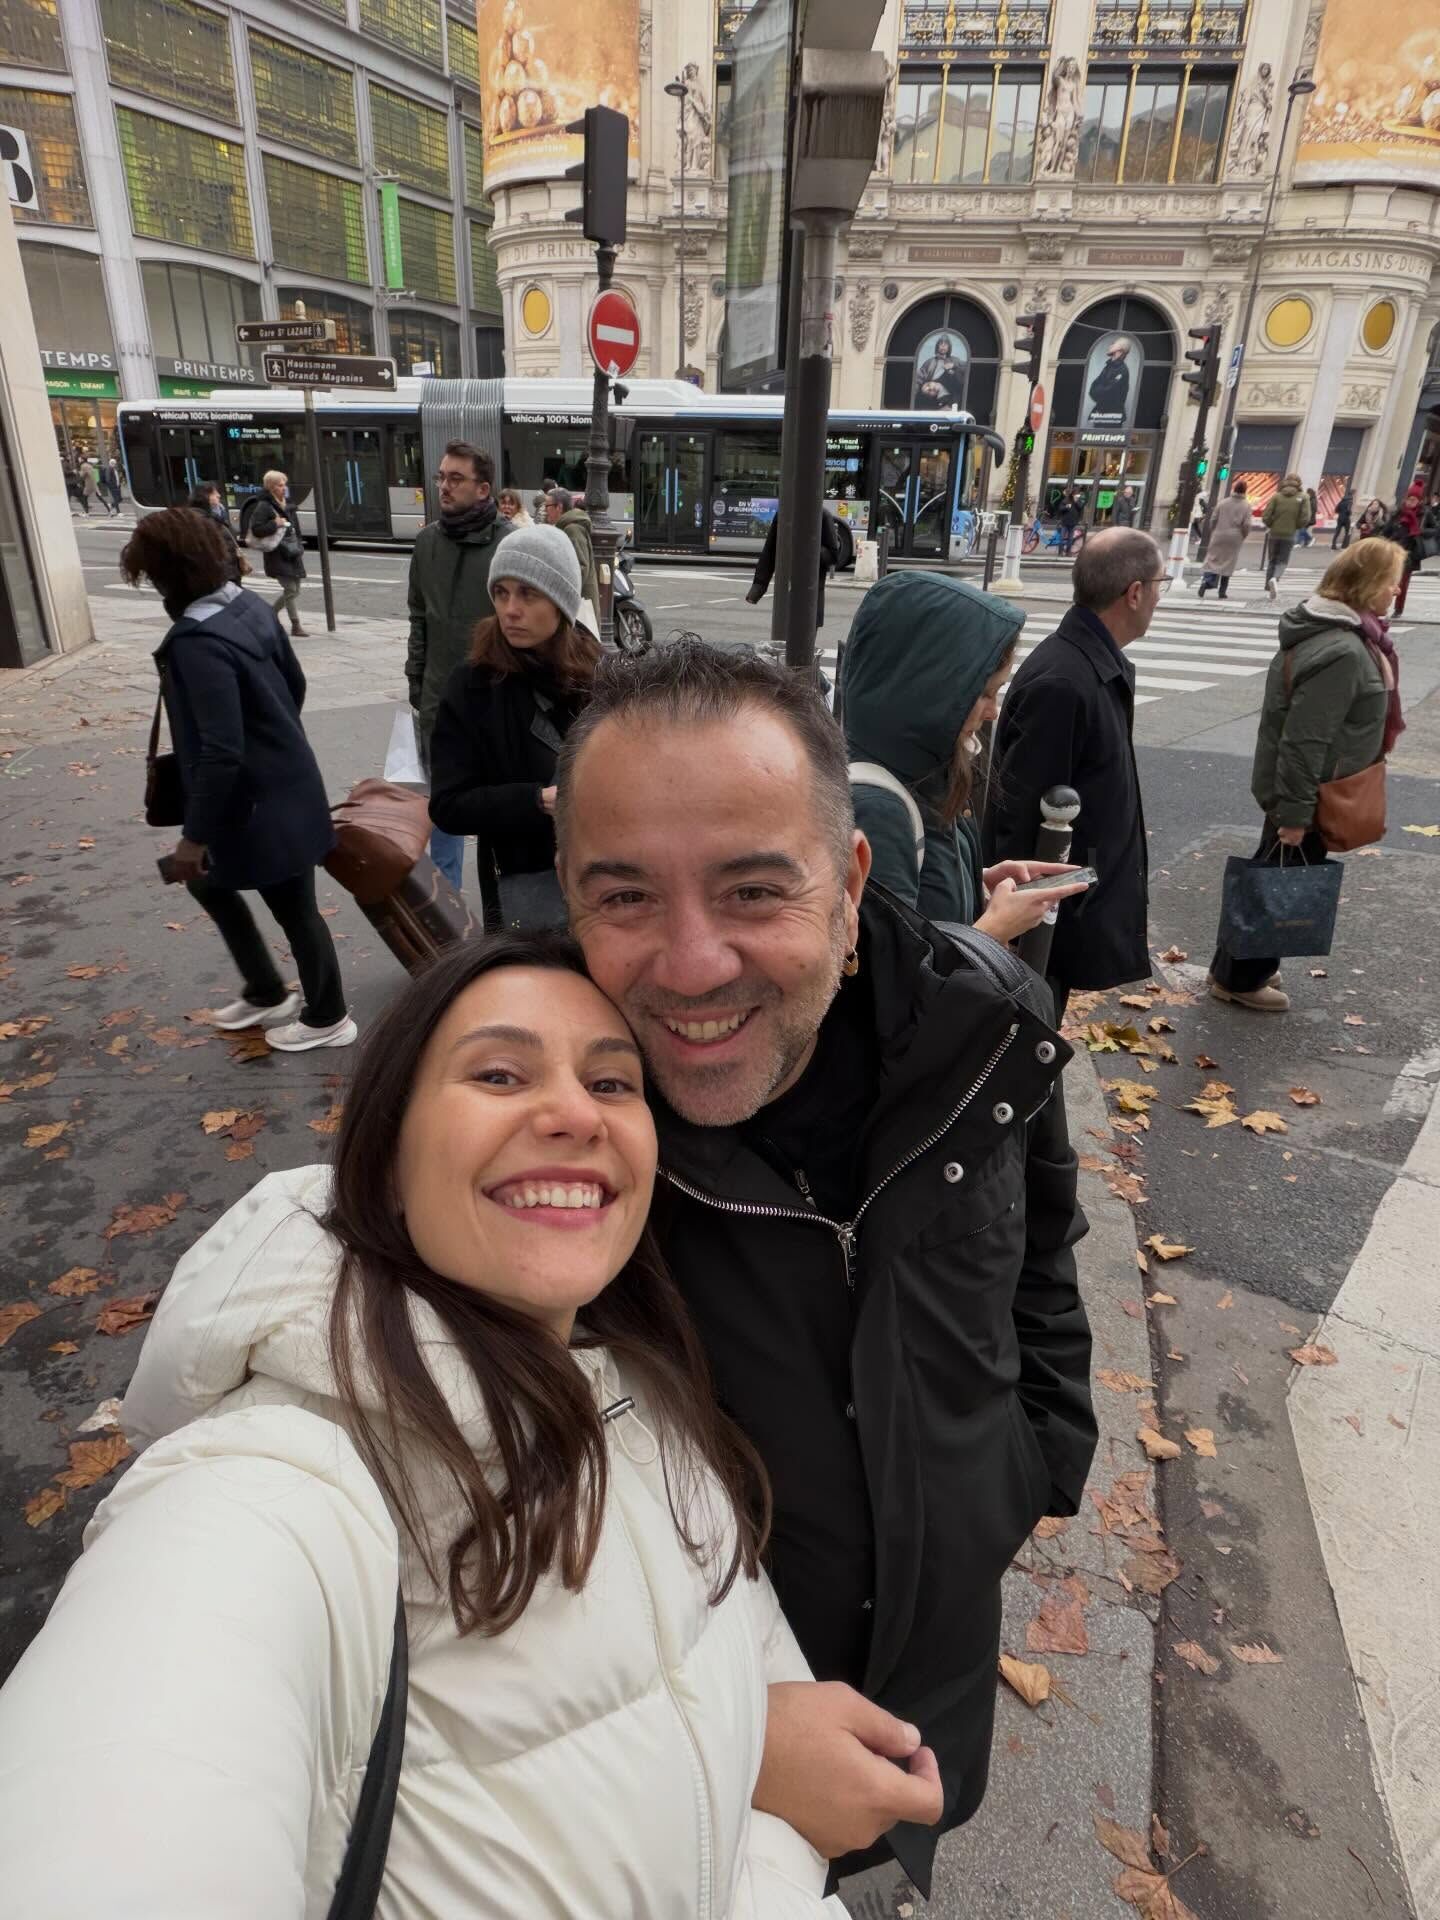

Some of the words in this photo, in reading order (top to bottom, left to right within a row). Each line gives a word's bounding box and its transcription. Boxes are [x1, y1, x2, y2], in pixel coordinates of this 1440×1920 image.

[537, 242, 637, 259] PRINTEPS
[1295, 252, 1394, 270] MAGASINS
[259, 328, 275, 337] Gare
[286, 326, 313, 337] LAZARE
[287, 359, 337, 370] Haussmann
[174, 360, 256, 382] PRINTEMPS
[288, 370, 320, 381] Grands
[322, 372, 364, 383] Magasins
[160, 411, 189, 421] véhicule
[190, 411, 209, 421] 100%
[210, 411, 254, 422] biométhane
[511, 414, 545, 424] véhicule
[546, 415, 569, 424] 100%
[570, 415, 593, 424] biom
[229, 427, 240, 439] 95
[1081, 433, 1126, 442] PRINTEMPS
